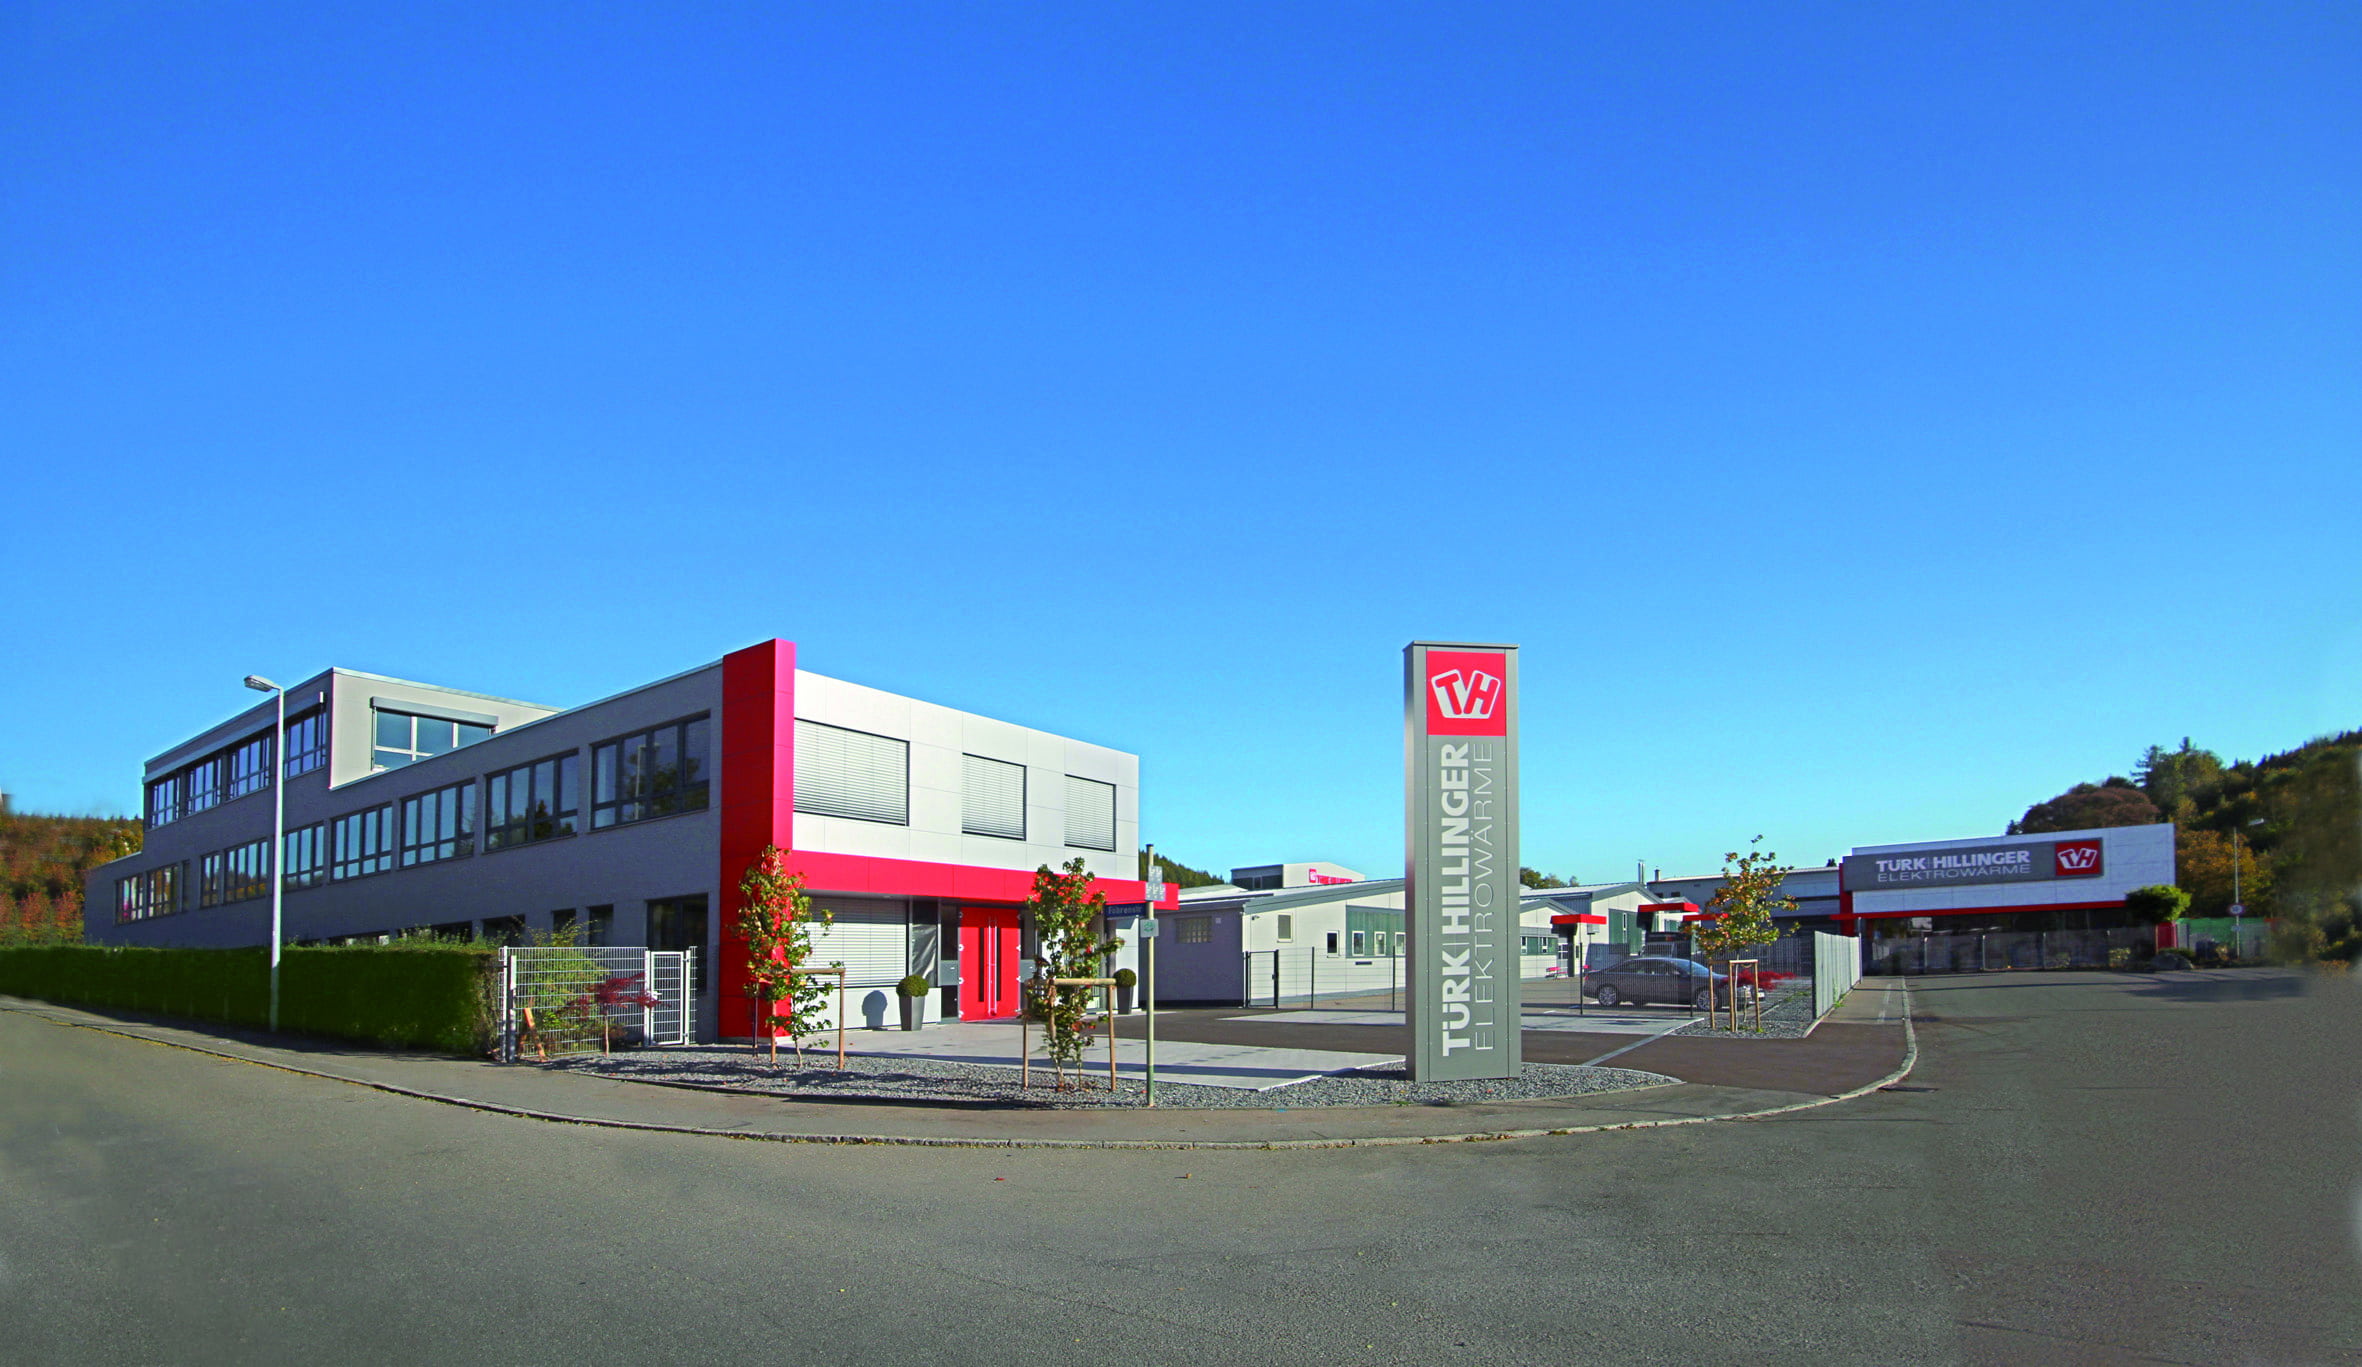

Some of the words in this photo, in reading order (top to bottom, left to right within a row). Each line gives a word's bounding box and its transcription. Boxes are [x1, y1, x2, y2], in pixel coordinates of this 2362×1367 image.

[1441, 742, 1470, 934] HILLINGER
[1471, 743, 1494, 1051] ELEKTROWÄRME
[1933, 850, 2031, 869] HILLINGER
[1442, 948, 1471, 1057] TÜRK
